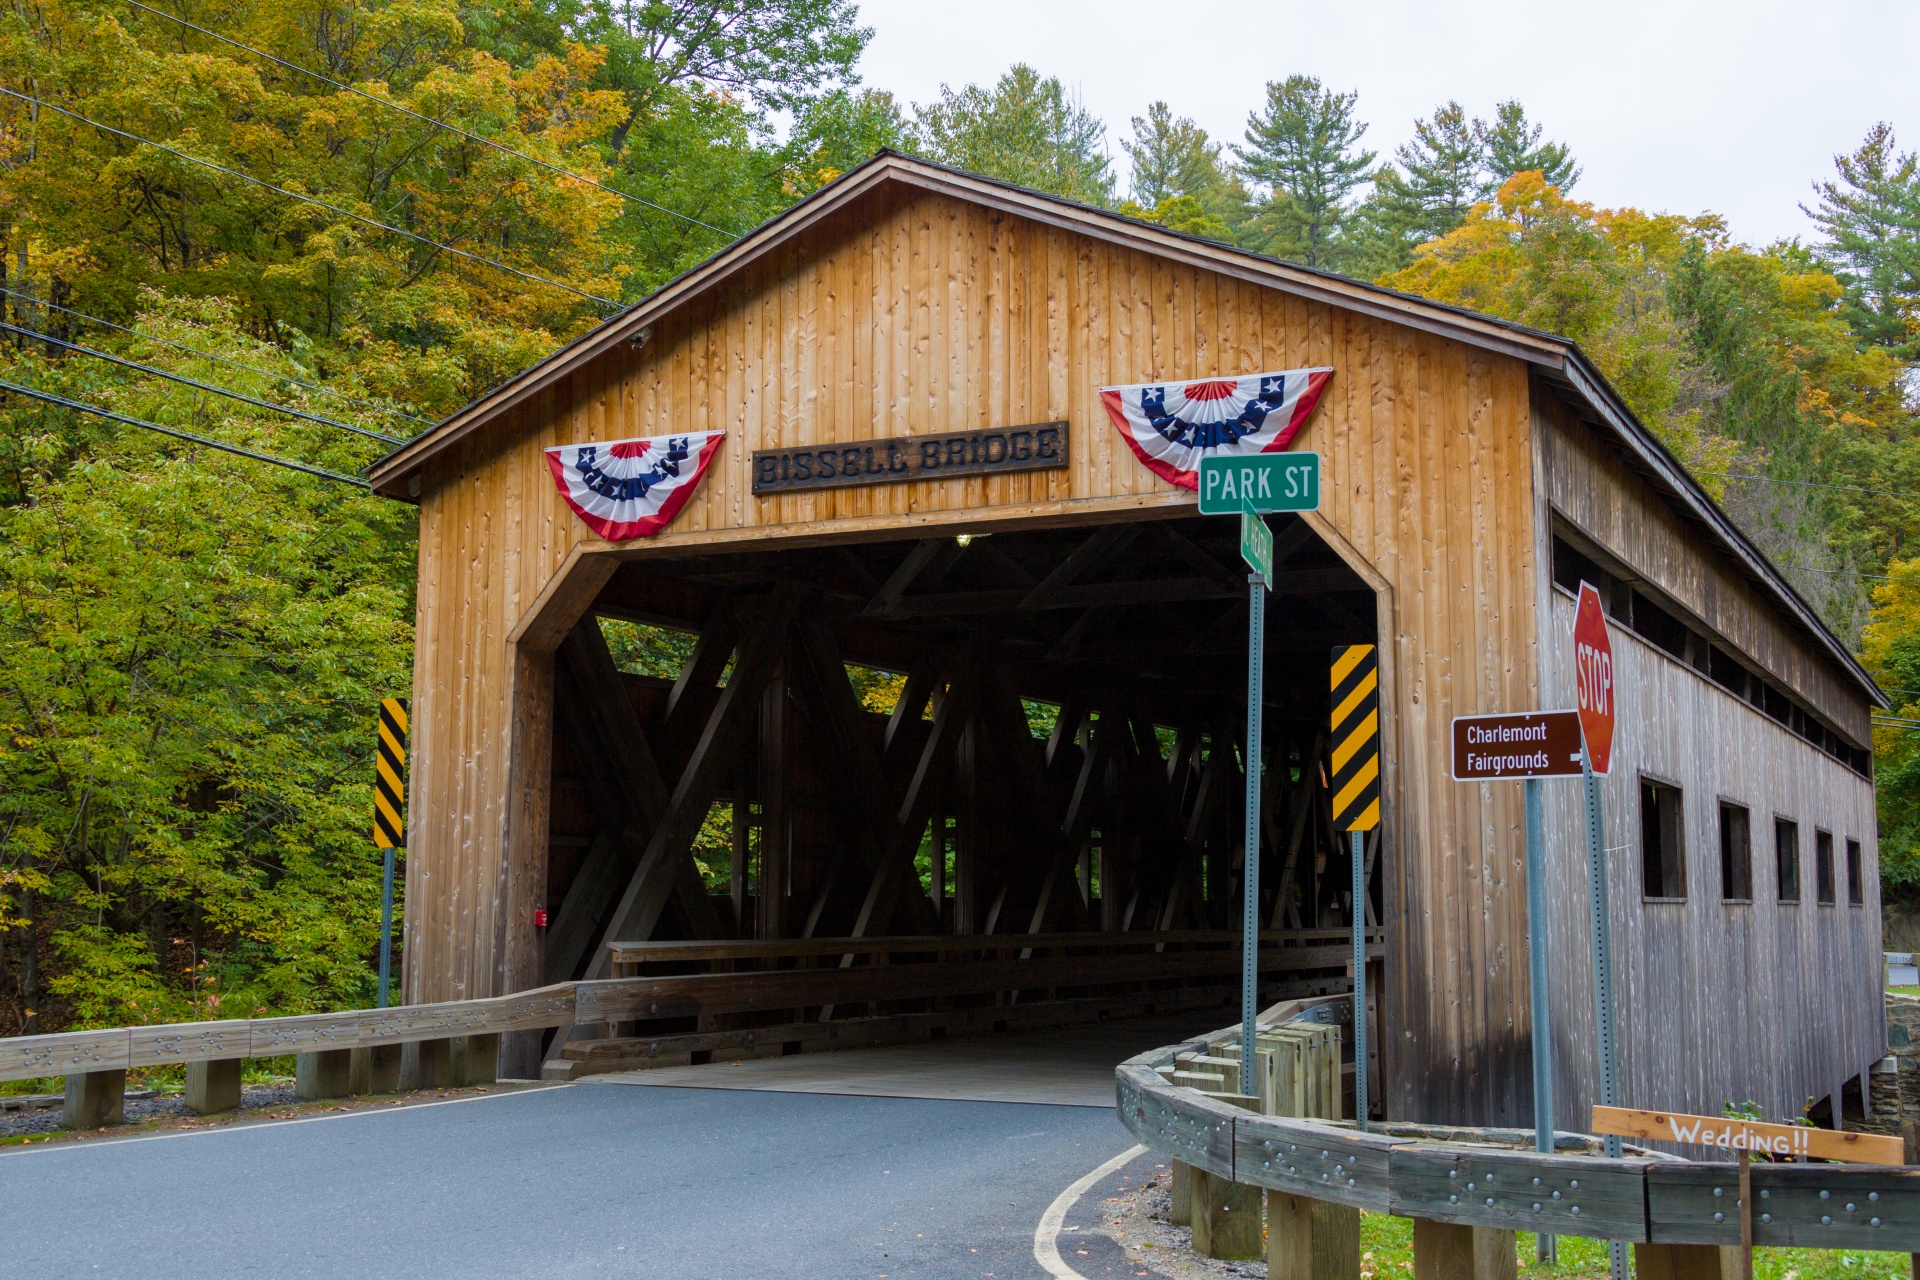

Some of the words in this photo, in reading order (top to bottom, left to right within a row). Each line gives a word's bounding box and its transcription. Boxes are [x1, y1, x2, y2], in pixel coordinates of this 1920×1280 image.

[757, 444, 908, 485] BISSELL
[919, 428, 1060, 472] BRIDGE
[1206, 467, 1272, 501] PARK
[1284, 465, 1313, 498] ST
[1250, 520, 1267, 569] HEATH
[1577, 641, 1611, 717] STOP
[1467, 722, 1547, 744] Charlemont
[1467, 750, 1549, 775] Fairgrounds
